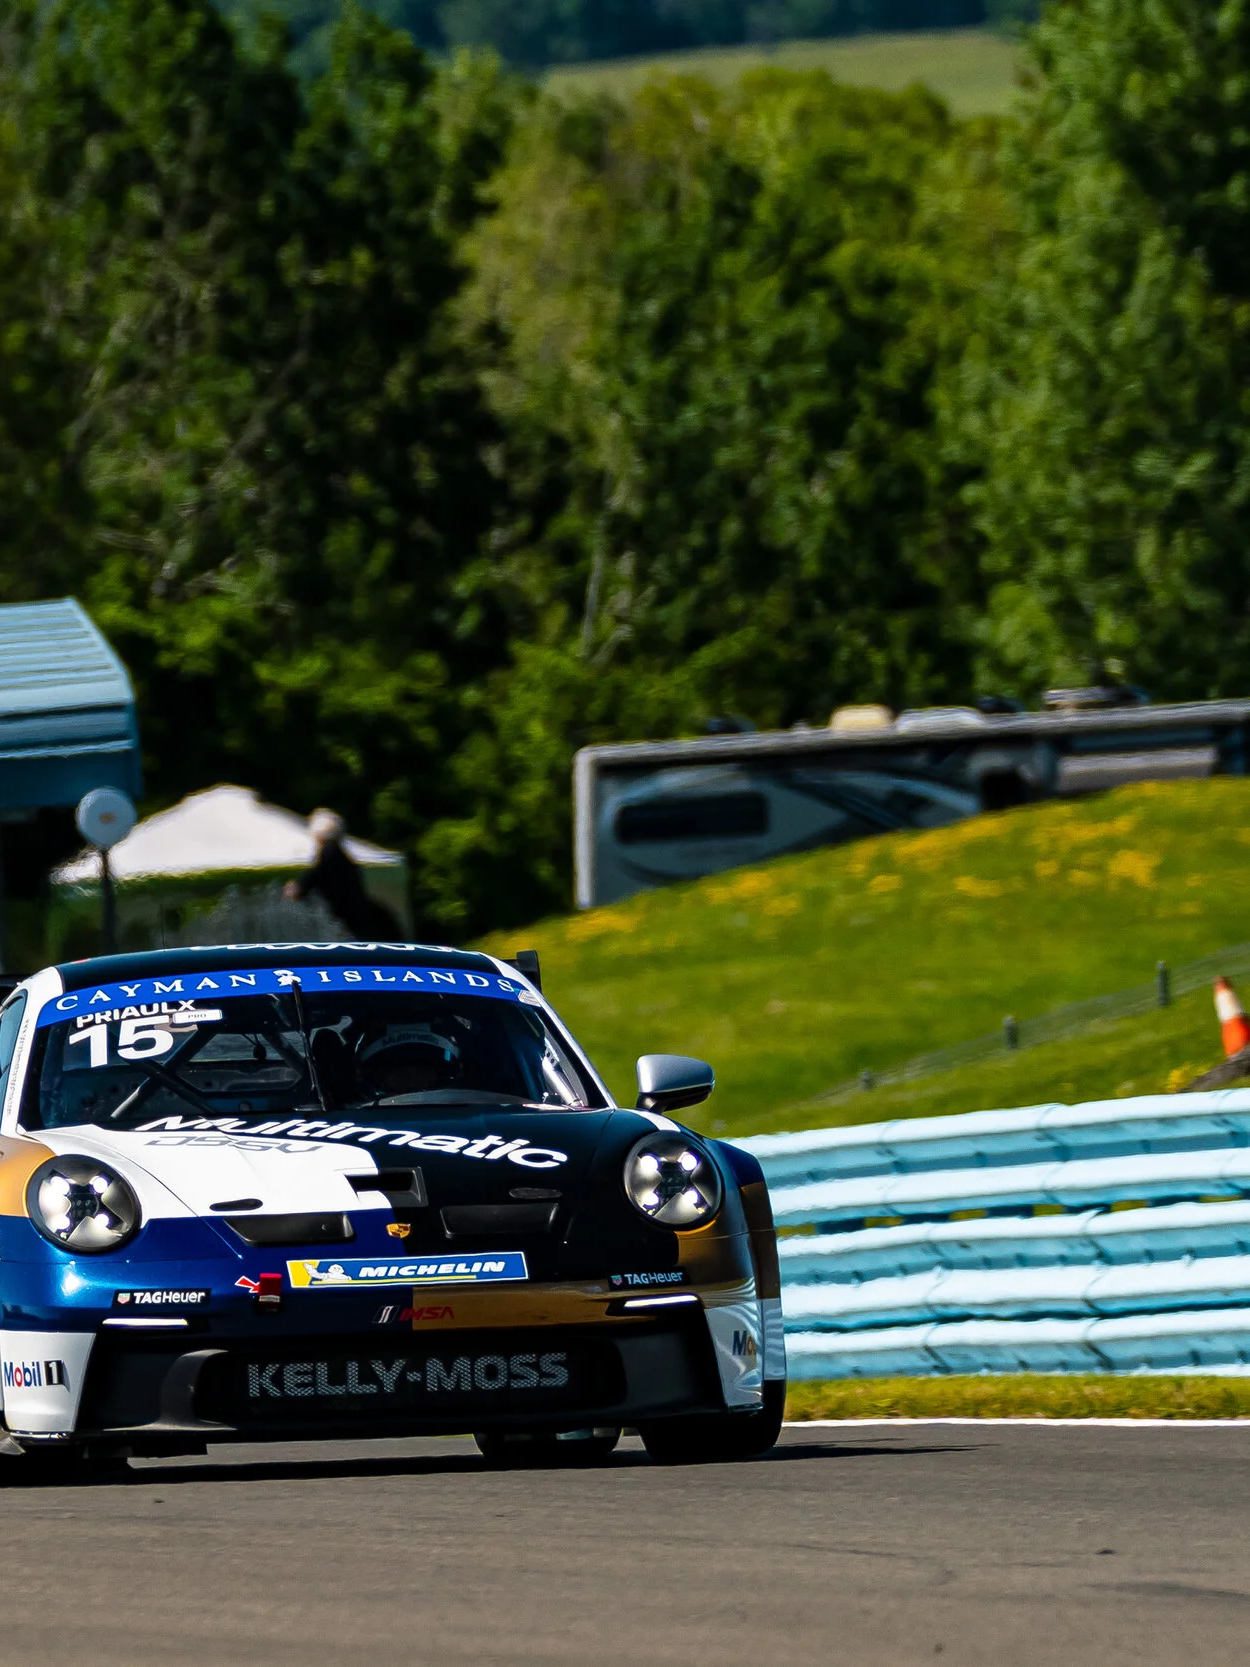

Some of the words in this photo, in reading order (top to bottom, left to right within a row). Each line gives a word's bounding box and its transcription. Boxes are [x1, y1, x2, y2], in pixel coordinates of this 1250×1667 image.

[55, 974, 258, 1011] CAYMAN
[317, 970, 515, 993] ISLANDS
[76, 999, 196, 1029] PRIAULX
[68, 1015, 174, 1068] 15
[134, 1114, 569, 1169] Multimatic
[358, 1261, 506, 1278] MICHELIN
[399, 1305, 455, 1321] IMSA
[3, 1361, 43, 1388] Mobil
